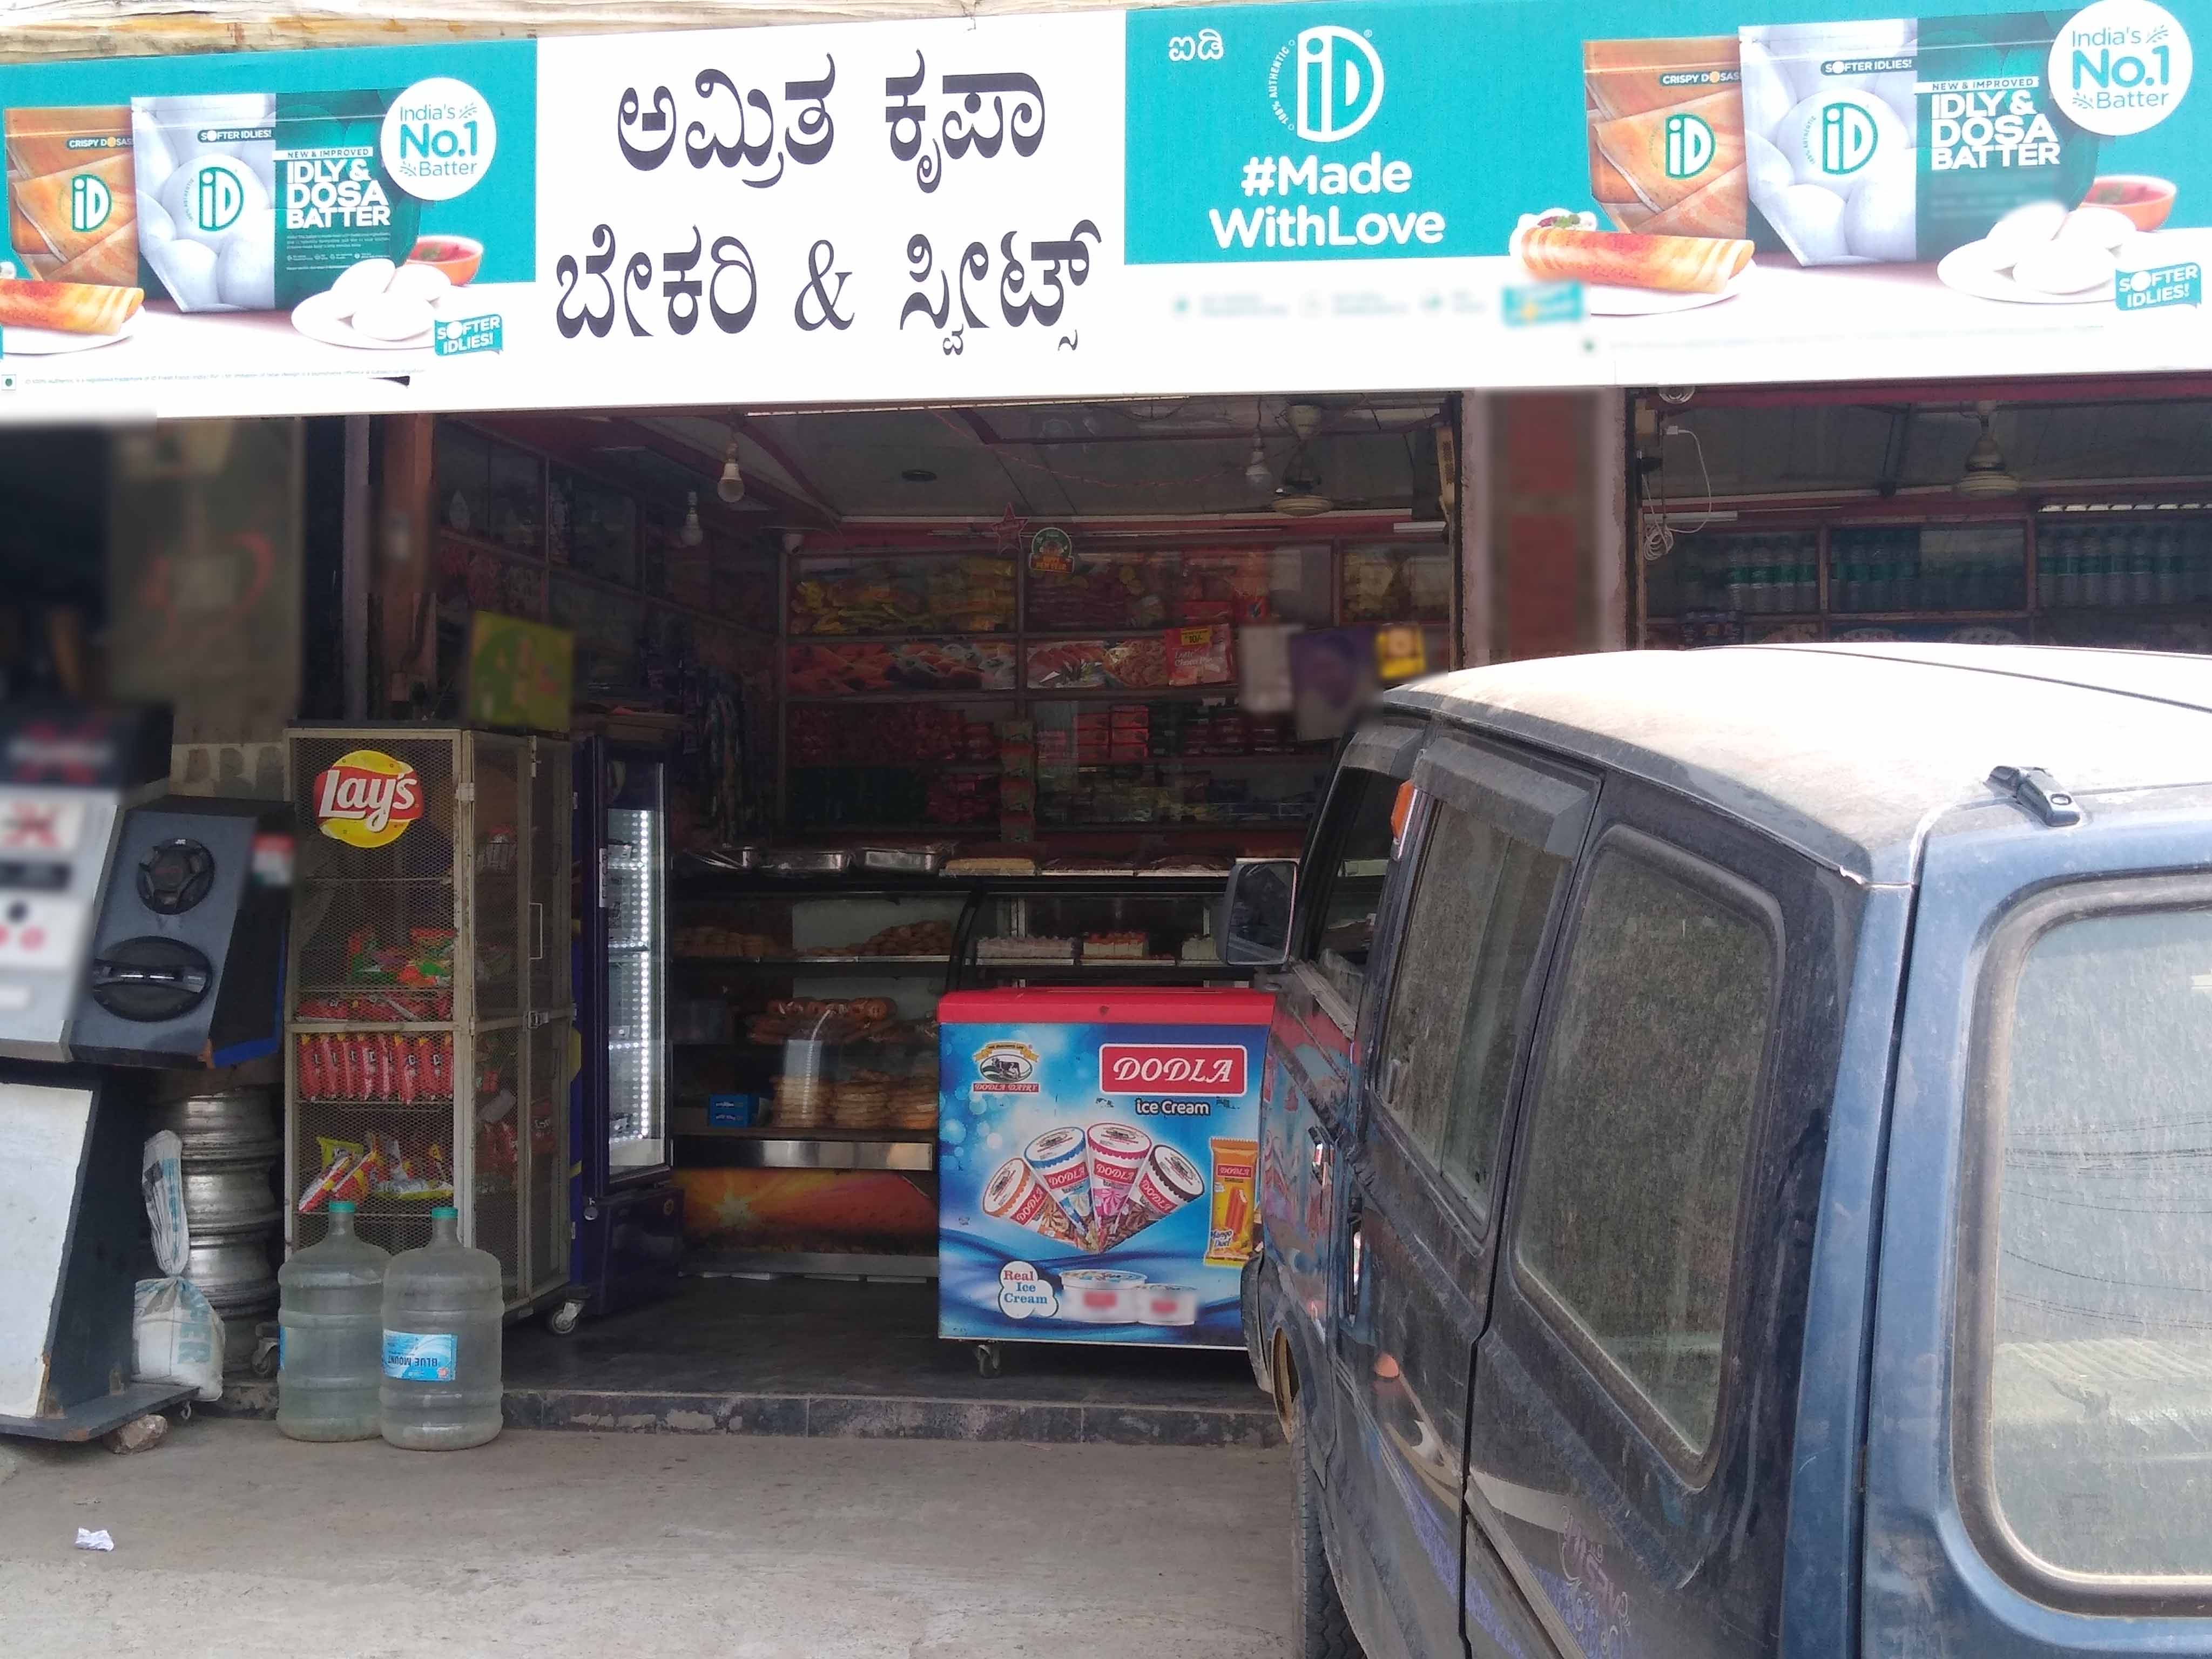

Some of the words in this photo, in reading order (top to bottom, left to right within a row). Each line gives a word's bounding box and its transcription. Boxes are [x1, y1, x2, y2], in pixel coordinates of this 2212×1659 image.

[1168, 28, 1225, 62] ಐಡಿ
[2072, 26, 2142, 48] India's
[1268, 45, 1290, 99] AUTHENTIC
[1874, 59, 1912, 70] IDLIES!
[2072, 45, 2169, 90] No.1
[1662, 73, 1700, 85] CRISPY
[1932, 82, 1959, 91] NEW
[1961, 81, 1968, 89] &
[1972, 78, 2034, 88] IMPROVED
[1931, 90, 2007, 119] IDLY
[2009, 89, 2039, 116] &
[2096, 91, 2169, 109] Batter
[400, 104, 456, 122] India's
[617, 51, 836, 188] ಅಮ್ರಿತ
[885, 49, 1046, 193] ಕೃಪಾ
[240, 129, 272, 139] IDLIES!
[400, 120, 478, 159] No.1
[1931, 113, 2059, 148] DOSA
[69, 138, 99, 149] CRISPY
[320, 148, 369, 158] IMPROVED
[1931, 142, 2061, 171] BATTER
[287, 158, 348, 184] IDLY
[349, 158, 372, 181] &
[419, 161, 478, 177] Batter
[1240, 151, 1413, 197] #Made
[286, 179, 389, 209] DOSA
[286, 205, 391, 230] BATTER
[1208, 204, 1446, 249] WithLove
[556, 224, 757, 339] ಬೇಕರಿ
[794, 239, 855, 331] &
[900, 219, 1102, 355] ಸ್ವೀಟ್ಸ್
[2127, 283, 2190, 308] IDLIES!
[443, 332, 494, 355] IDLIES!
[319, 770, 417, 833] Lay's
[1112, 1057, 1233, 1083] DODLA
[1136, 1098, 1158, 1114] ice
[1161, 1100, 1210, 1115] Cream
[1048, 1165, 1086, 1185] DODLA
[1096, 1163, 1135, 1181] DODLA
[1016, 1188, 1044, 1222] DODLA
[1141, 1178, 1172, 1211] DODLA
[1003, 1270, 1034, 1281] Real
[1015, 1282, 1036, 1292] Ice
[1003, 1292, 1048, 1304] Cream
[388, 1355, 412, 1367] MOUNT
[414, 1357, 438, 1367] BLUE
